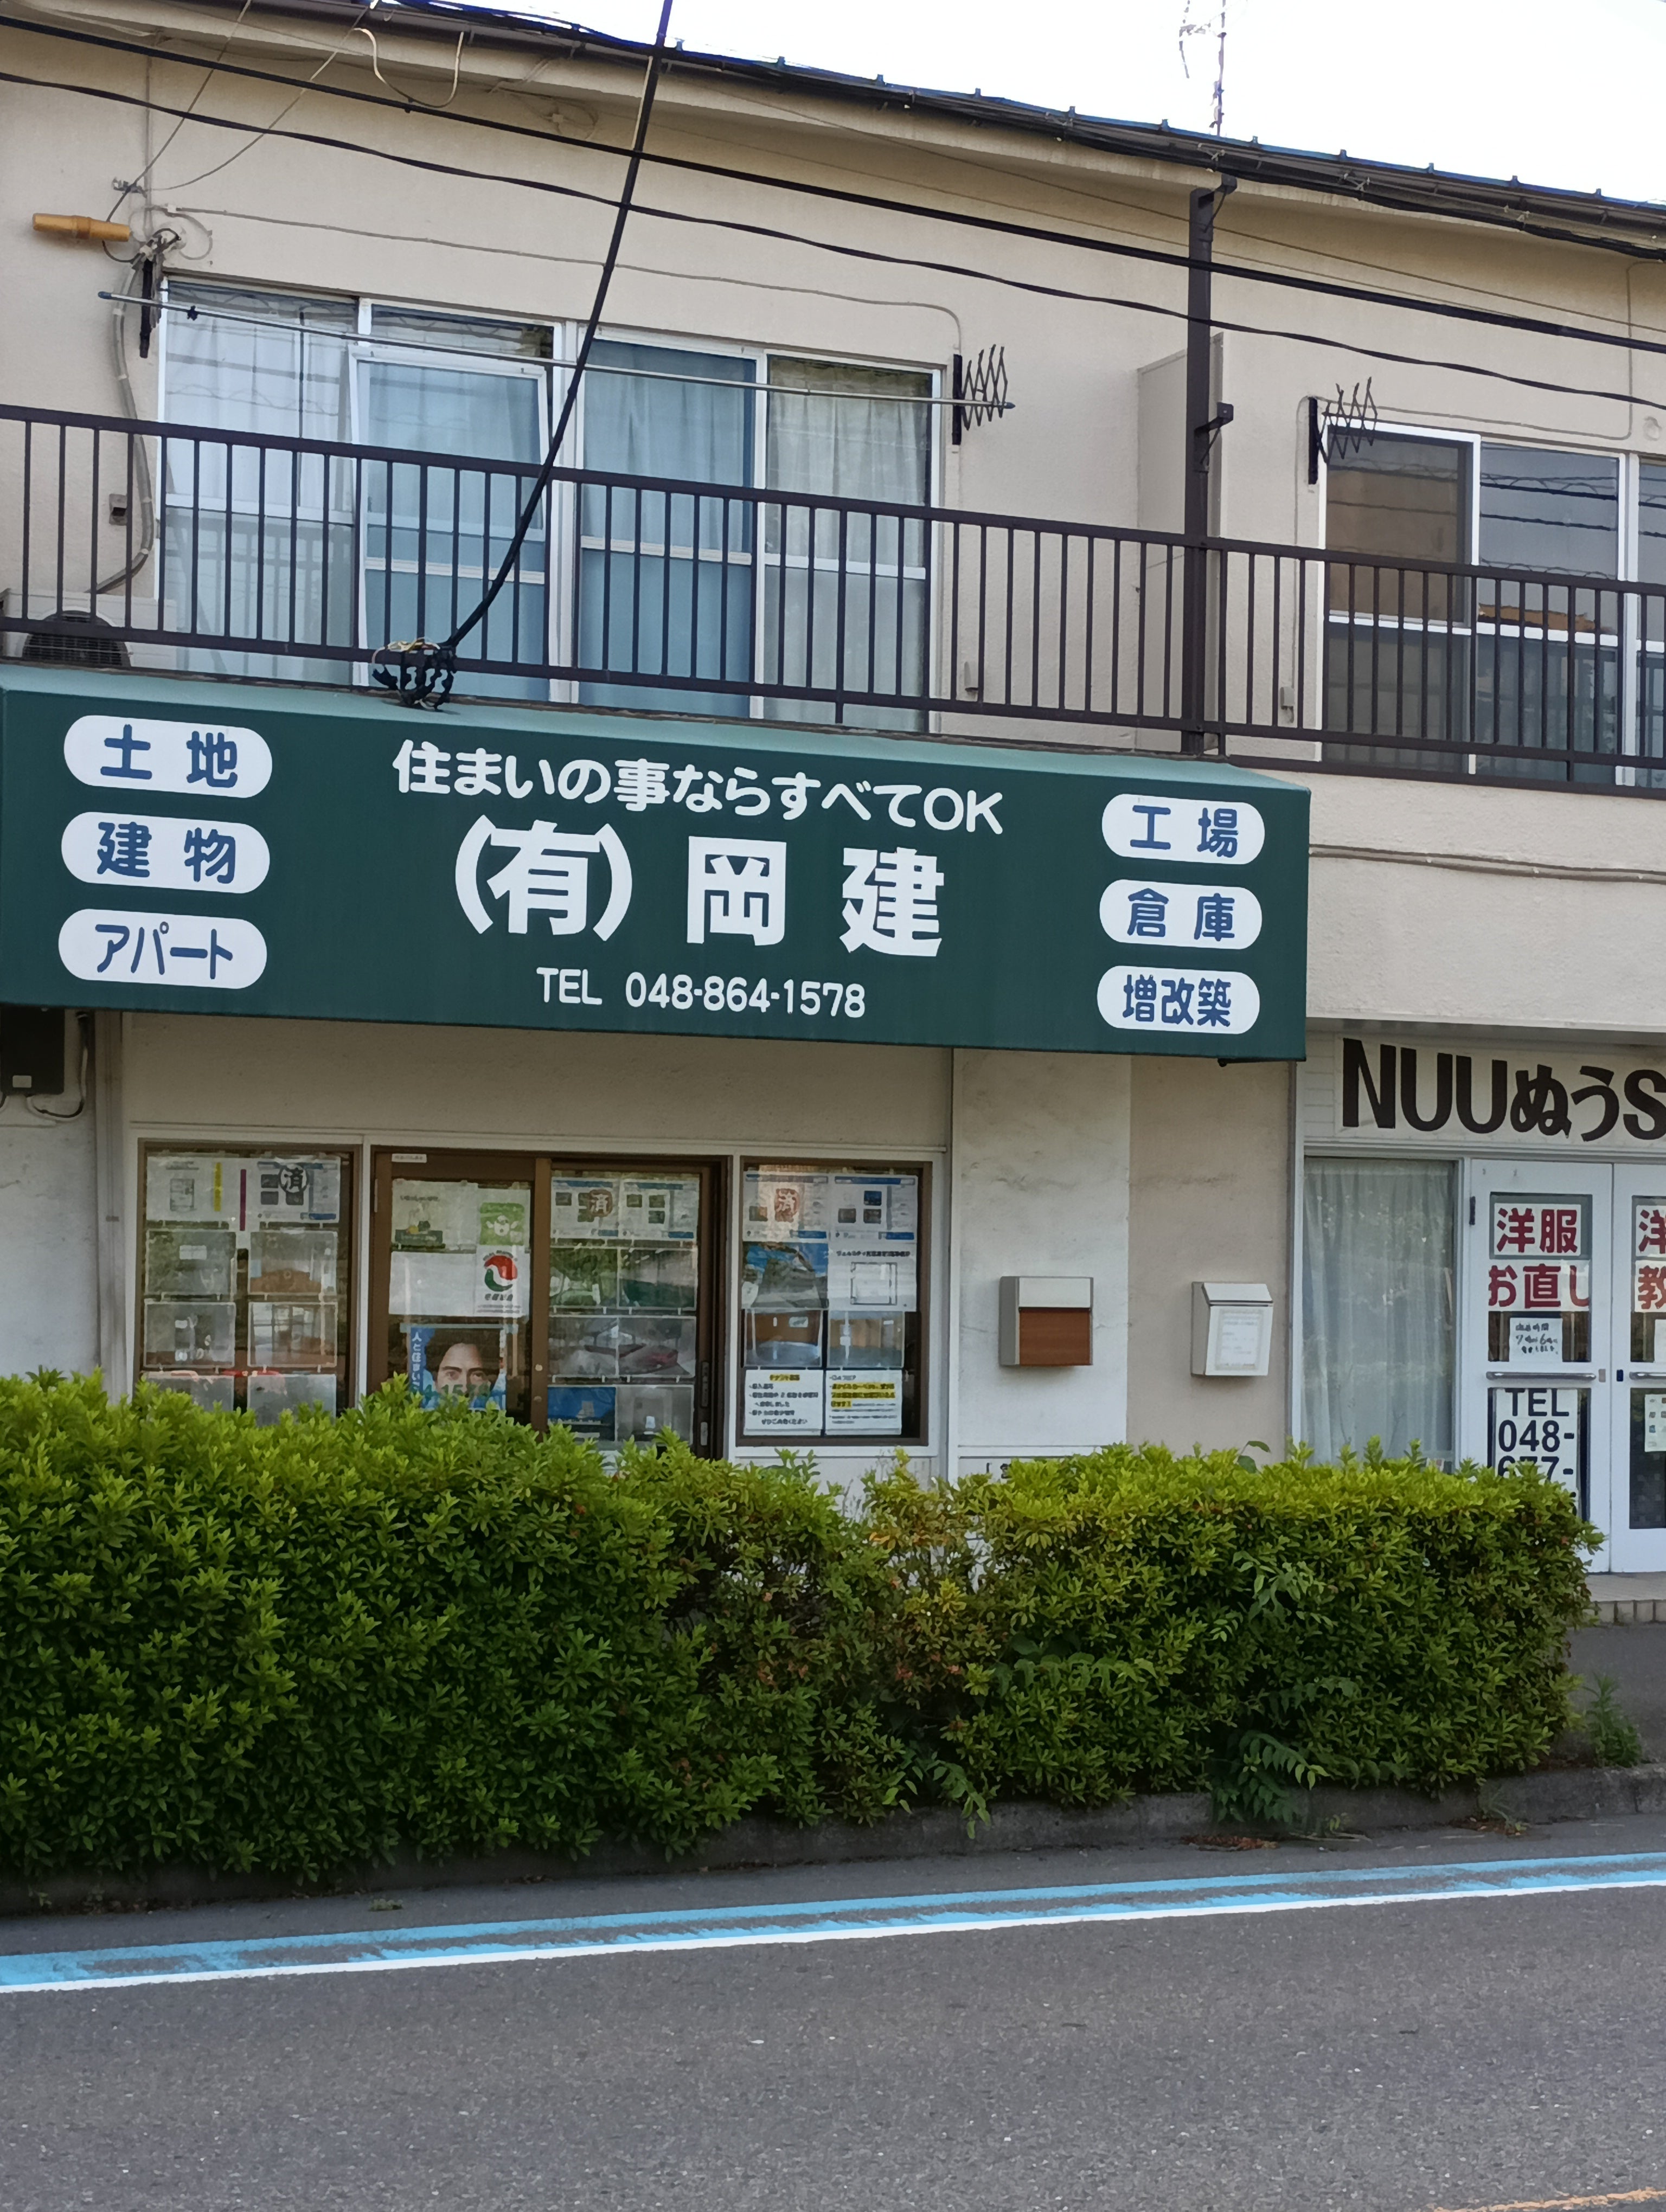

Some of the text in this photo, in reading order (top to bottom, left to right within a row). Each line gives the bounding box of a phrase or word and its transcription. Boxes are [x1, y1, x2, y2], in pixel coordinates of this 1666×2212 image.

[100, 725, 238, 788] 土地
[393, 739, 1003, 834] 住まいの事ならすべてOK
[97, 821, 235, 884] 建物
[1130, 805, 1239, 859] 工場
[1127, 888, 1235, 942] 倉庫
[94, 921, 234, 980] アパート
[536, 967, 866, 1018] TEL 048-864-1578
[1123, 974, 1232, 1027] 増改築
[1497, 1208, 1578, 1253] 洋服
[1488, 1264, 1589, 1309] お直し
[1504, 1388, 1569, 1417] TEL
[1498, 1419, 1574, 1452] 048-
